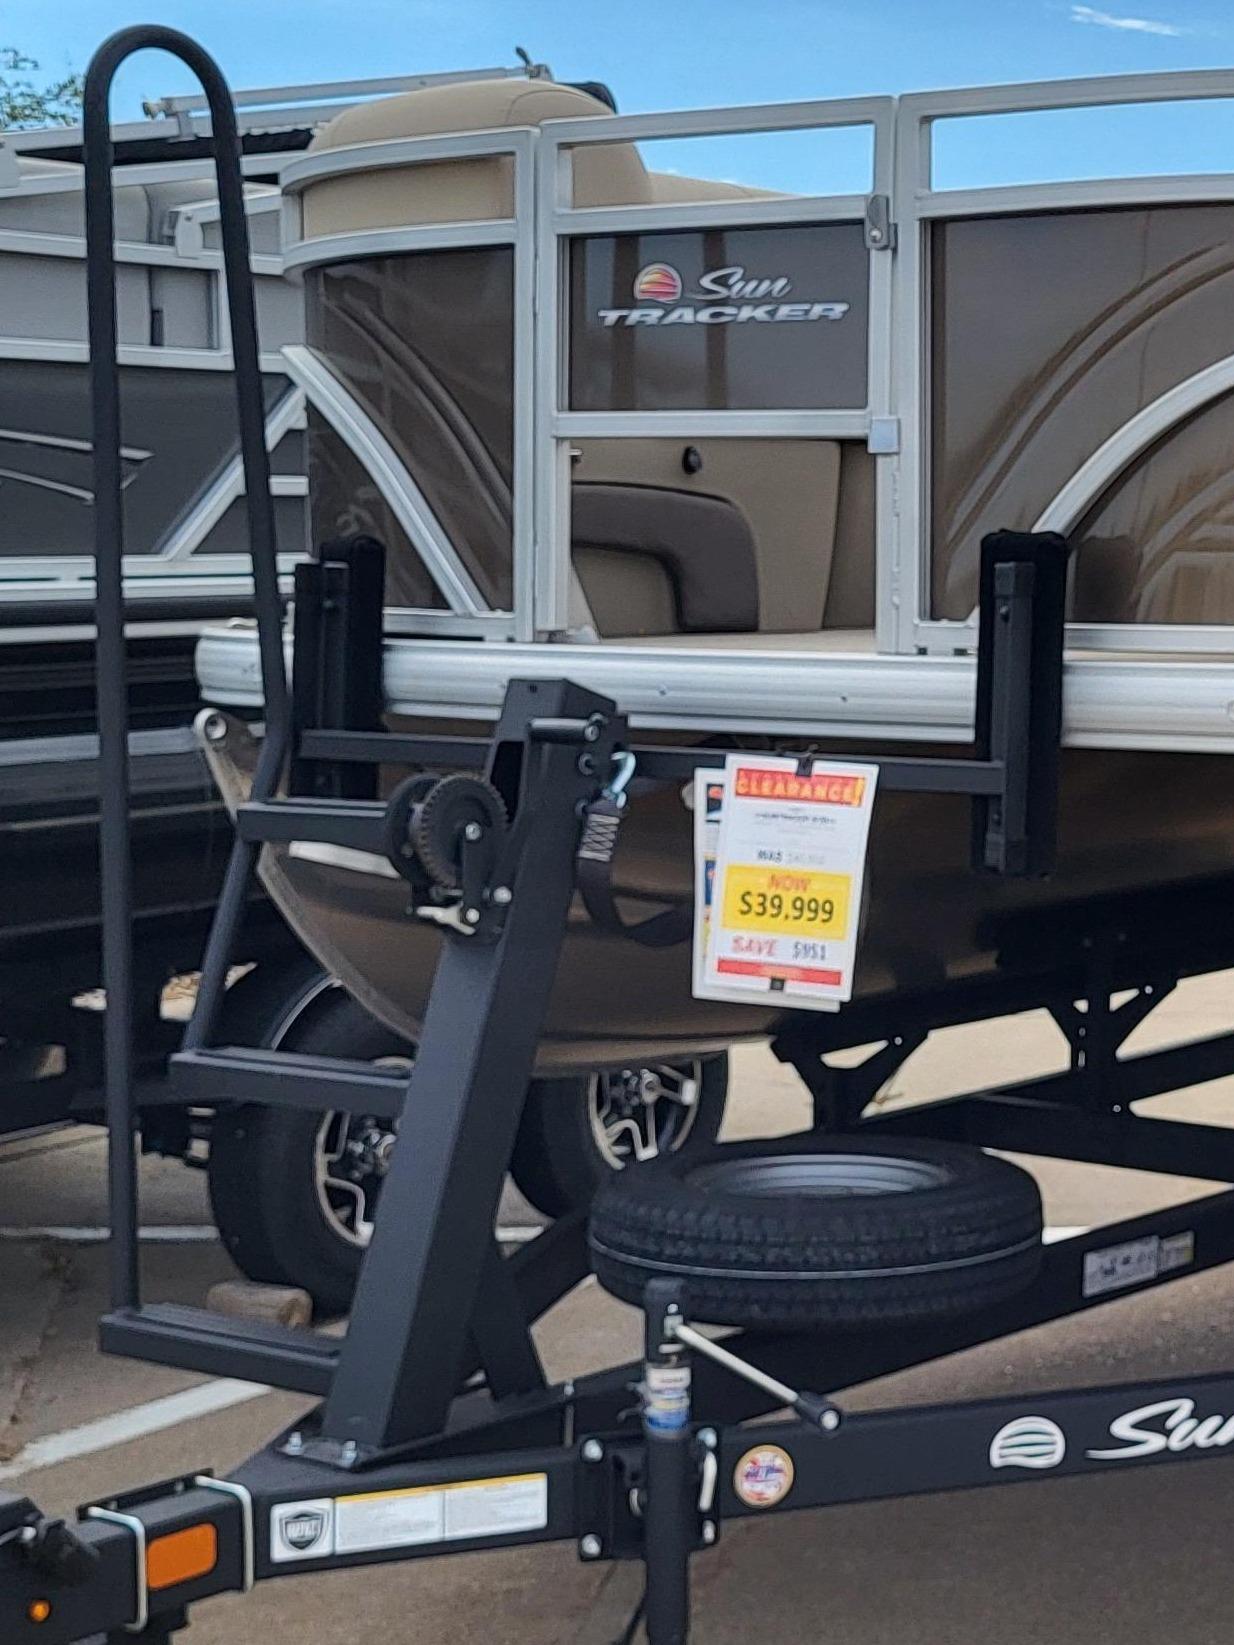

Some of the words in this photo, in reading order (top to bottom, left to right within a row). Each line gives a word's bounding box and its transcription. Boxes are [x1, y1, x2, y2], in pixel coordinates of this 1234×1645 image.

[688, 266, 792, 301] Sun
[597, 302, 850, 327] TRACKER
[767, 874, 812, 892] NOW
[731, 935, 779, 957] SAVE
